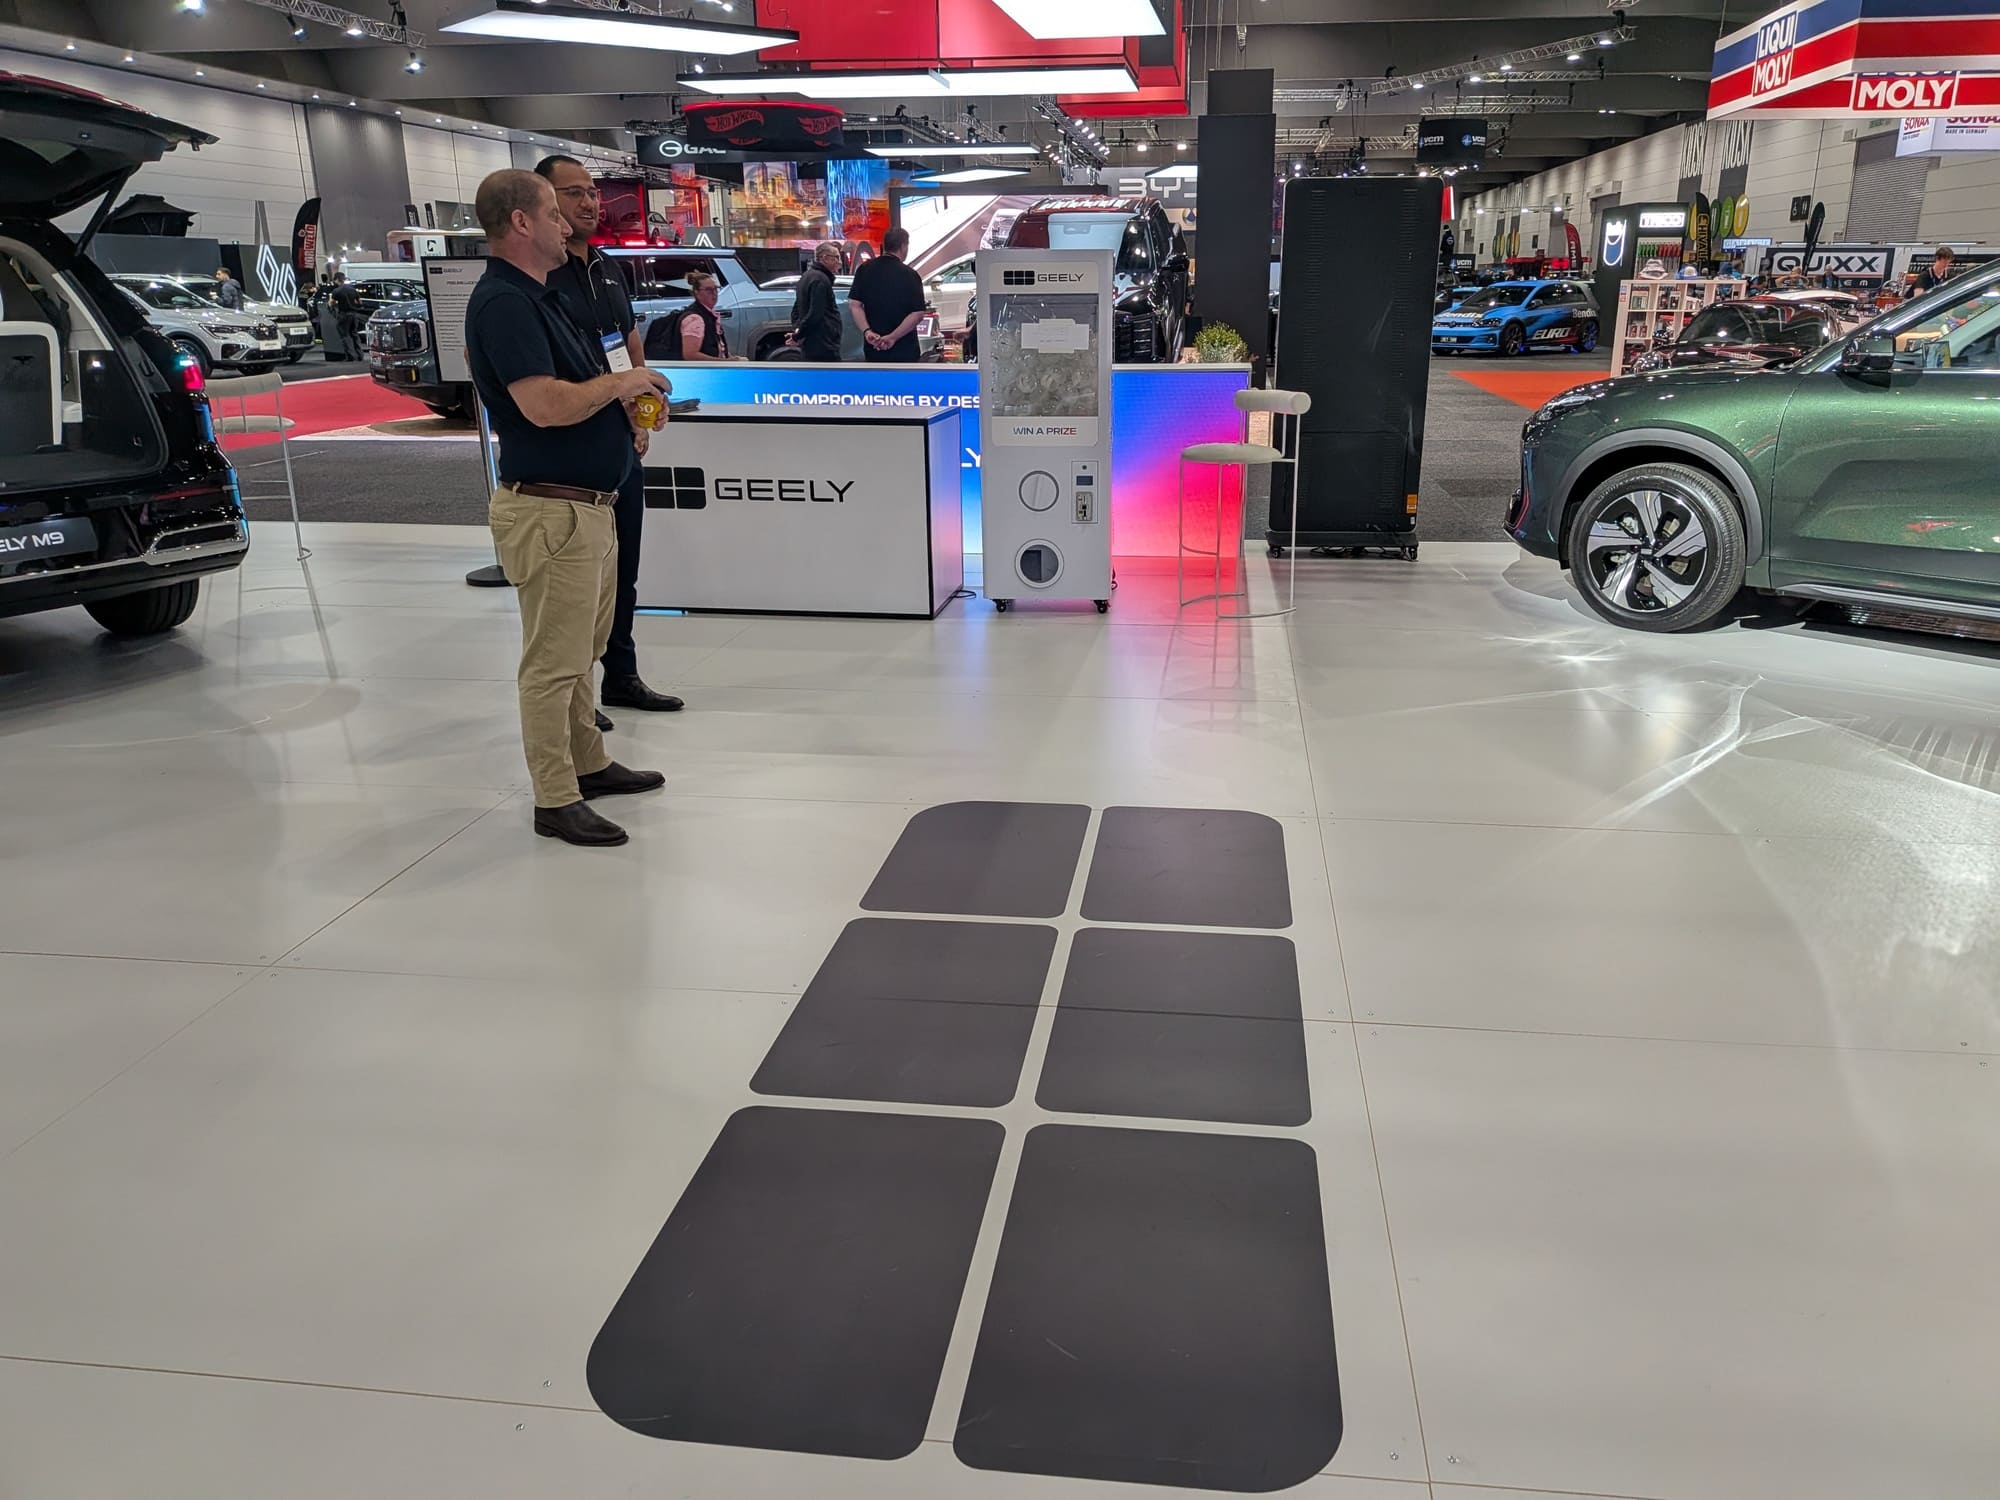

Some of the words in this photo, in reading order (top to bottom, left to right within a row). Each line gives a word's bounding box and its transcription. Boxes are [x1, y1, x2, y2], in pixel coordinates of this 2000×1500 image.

[1758, 13, 1797, 59] LIQUI
[1754, 51, 1792, 93] MOLY
[1857, 79, 1955, 109] MOLY
[1037, 273, 1084, 282] GEELY
[754, 393, 914, 407] UNCOMPROMISING
[918, 395, 944, 407] BY
[1013, 427, 1034, 435] WIN
[1036, 427, 1044, 435] A
[1046, 427, 1078, 436] PRIZE
[714, 478, 855, 503] GEELY
[31, 531, 65, 548] M9
